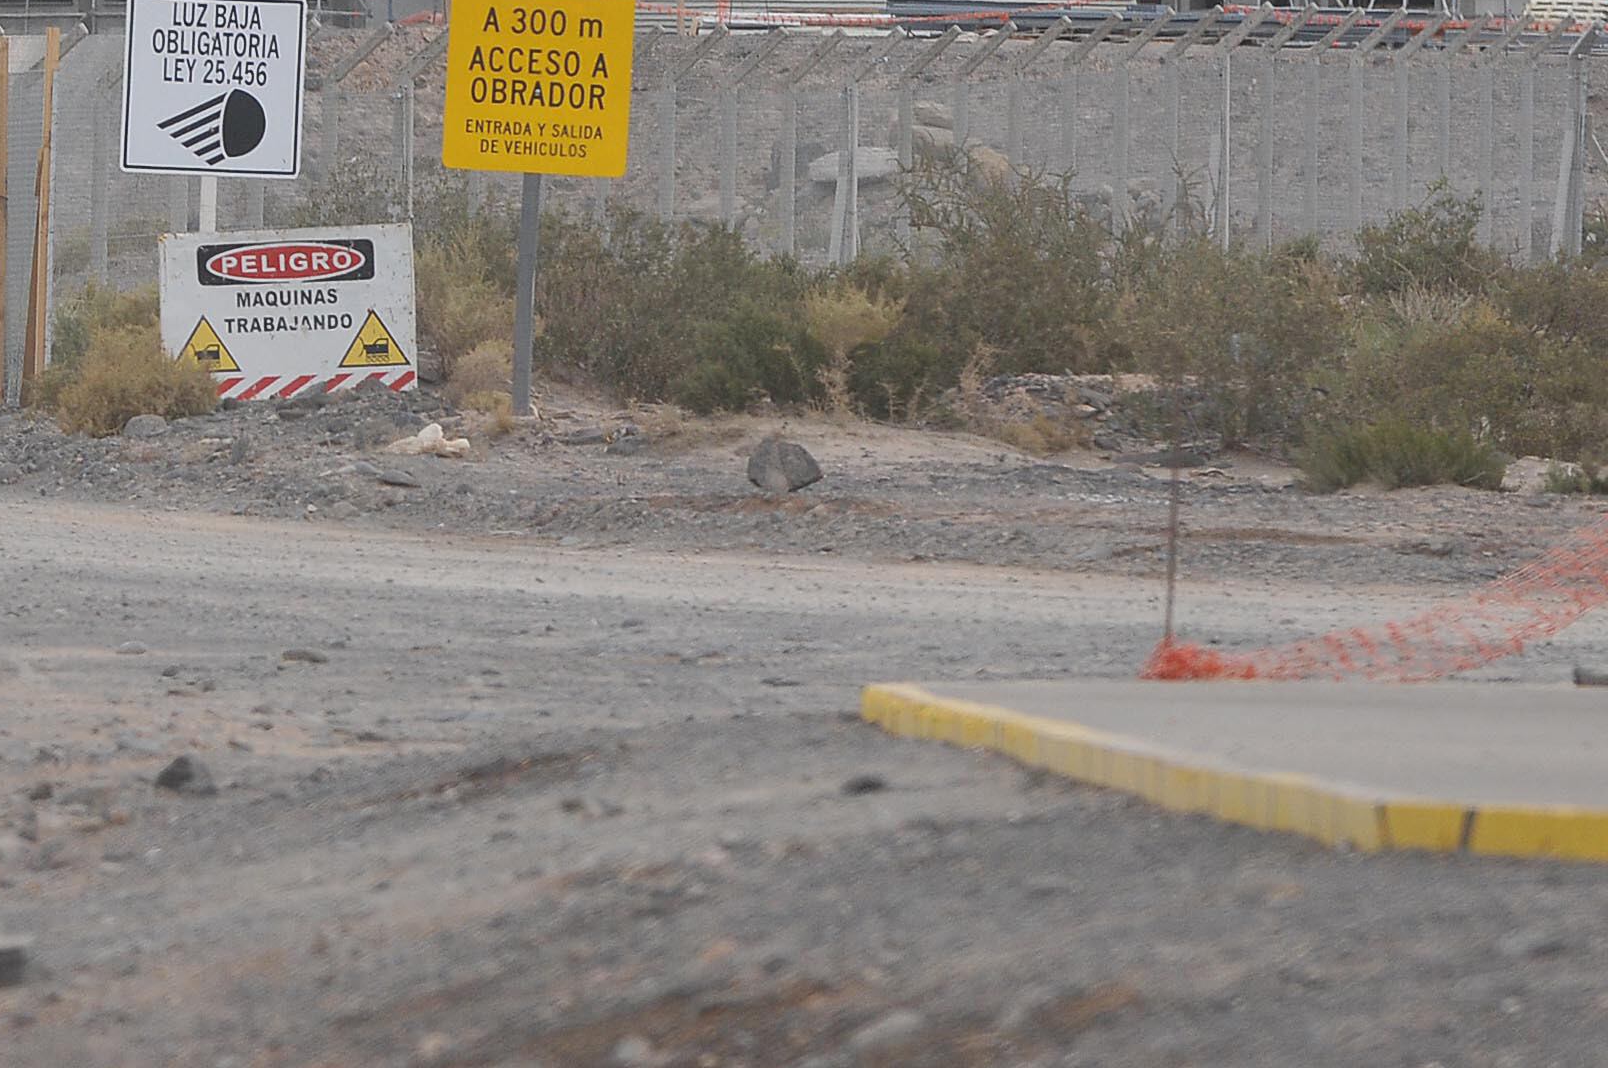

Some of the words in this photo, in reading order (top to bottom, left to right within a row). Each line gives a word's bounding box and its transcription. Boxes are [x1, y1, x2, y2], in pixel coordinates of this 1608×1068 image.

[173, 2, 208, 27] LUZ
[215, 4, 261, 30] BAJA
[482, 6, 500, 33] A
[511, 7, 567, 36] 300
[579, 18, 603, 38] m
[152, 29, 279, 59] OBLIGATORIA
[163, 57, 196, 83] LEY
[203, 59, 267, 86] 25.456
[468, 45, 580, 77] ACCESO
[591, 52, 608, 78] A
[471, 77, 605, 110] OBRADOR
[465, 118, 532, 136] ENTRADA
[537, 123, 546, 137] Y
[552, 124, 603, 140] SALIDA
[480, 139, 499, 153] DE
[504, 140, 587, 158] VEHICULOS
[221, 251, 352, 274] PELIGRO
[236, 288, 338, 308] MAQUINAS
[224, 313, 353, 334] TRABAJANDO
